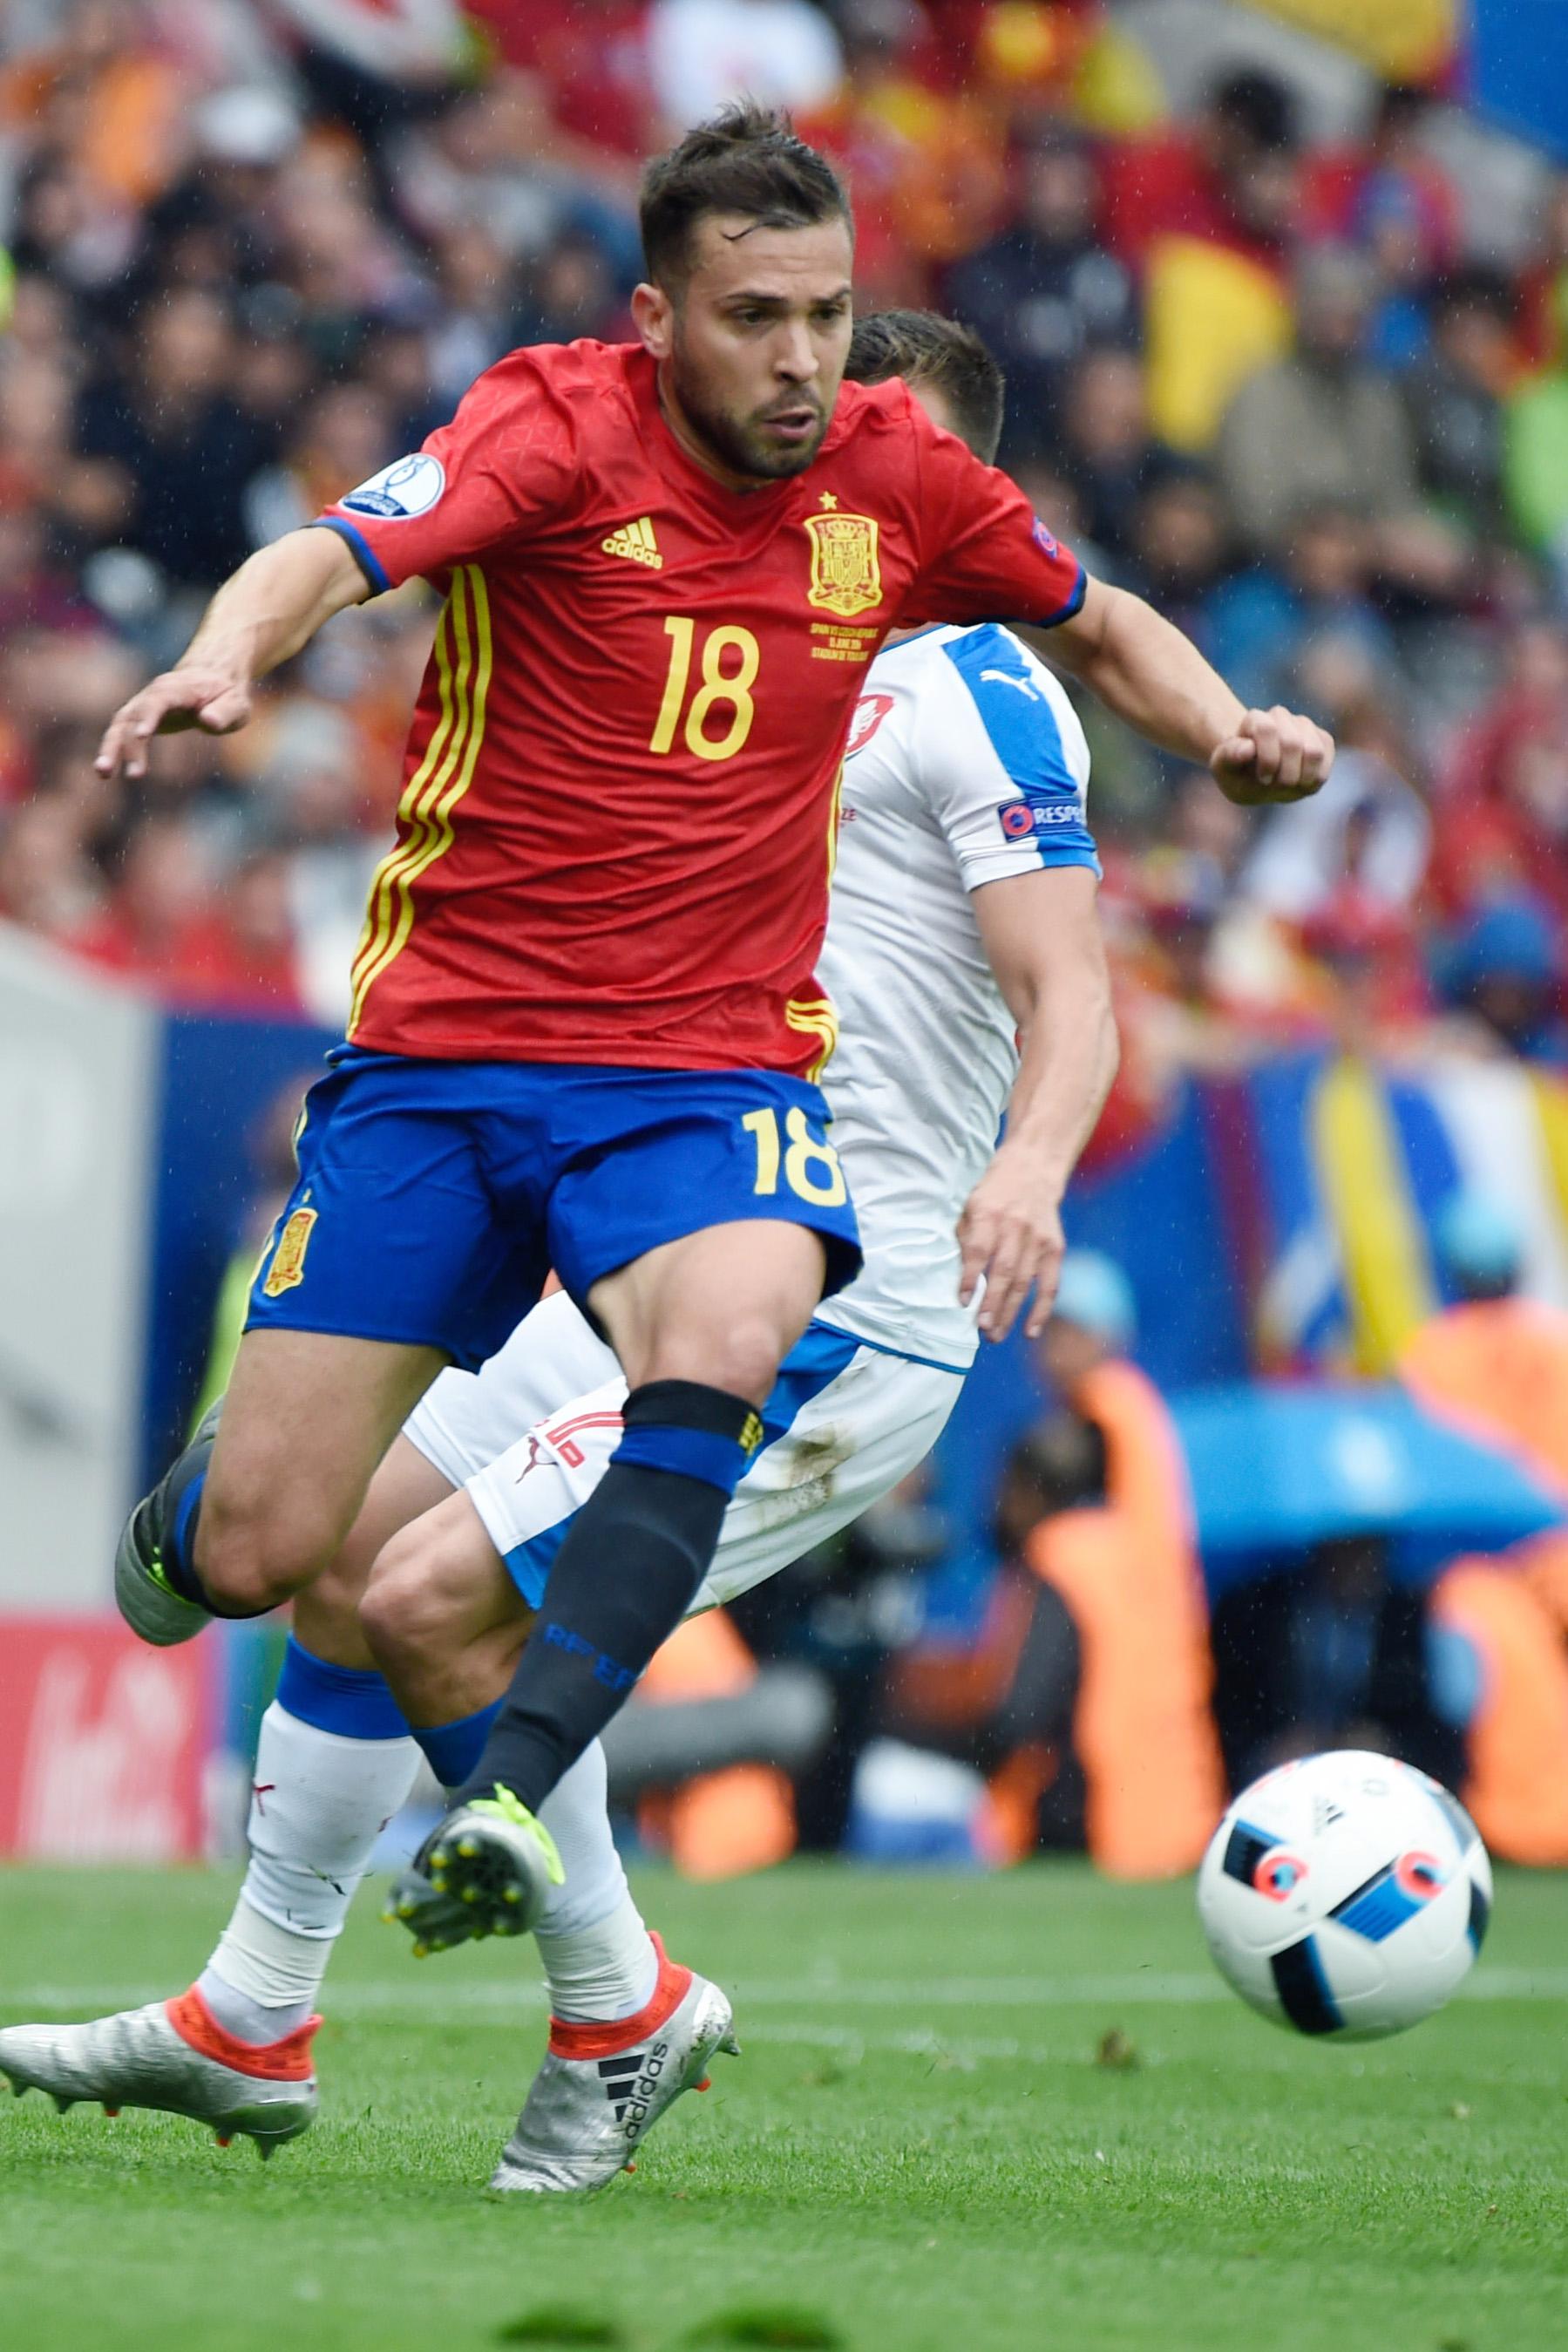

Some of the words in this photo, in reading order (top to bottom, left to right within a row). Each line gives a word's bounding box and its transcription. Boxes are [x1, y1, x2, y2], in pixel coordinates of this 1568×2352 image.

[601, 537, 663, 570] adidas
[649, 615, 760, 761] 18
[742, 1106, 847, 1207] 18
[625, 2042, 669, 2138] adidas
